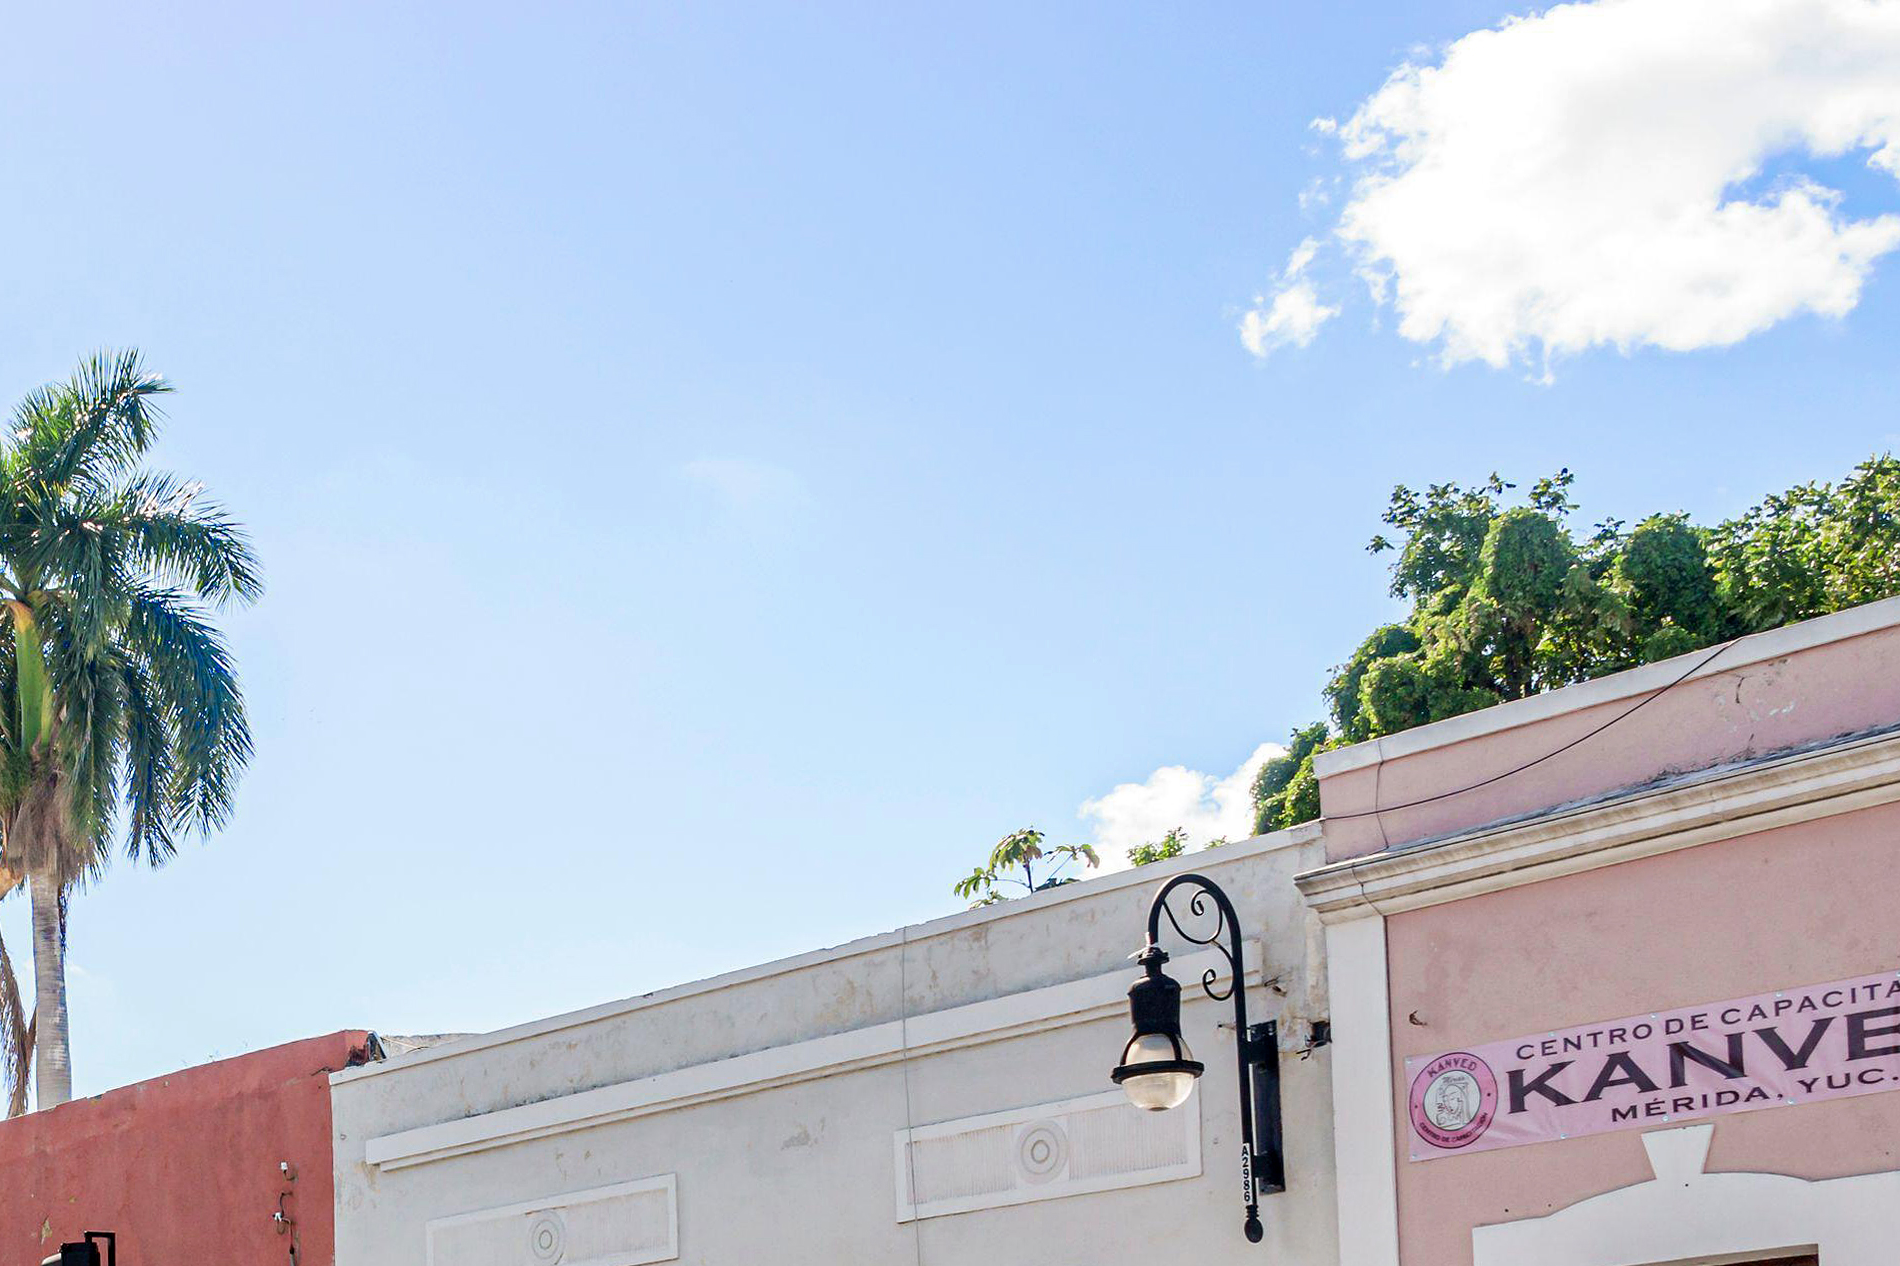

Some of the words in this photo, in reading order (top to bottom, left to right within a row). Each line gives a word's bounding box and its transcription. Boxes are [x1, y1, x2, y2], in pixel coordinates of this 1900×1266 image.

[1506, 1006, 1900, 1115] KANVE
[1516, 1023, 1653, 1060] CENTRO
[1665, 1013, 1710, 1036] DE
[1427, 1057, 1478, 1078] KANVED
[1611, 1086, 1784, 1122] MÉRIDA,
[1797, 1068, 1899, 1094] YUC.
